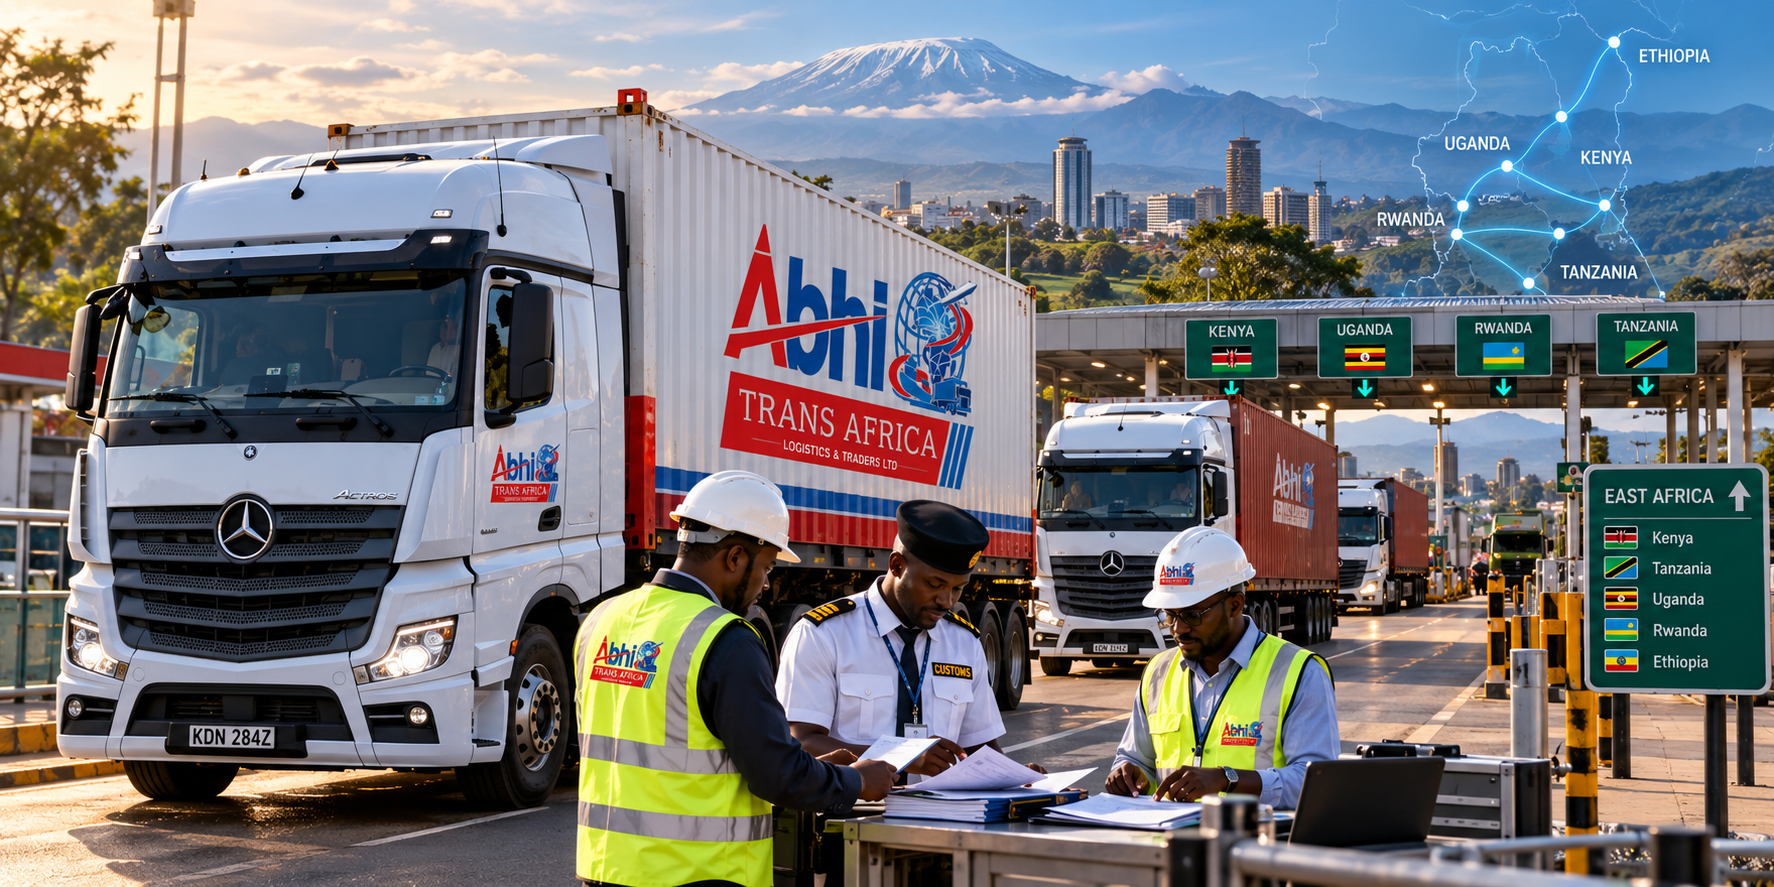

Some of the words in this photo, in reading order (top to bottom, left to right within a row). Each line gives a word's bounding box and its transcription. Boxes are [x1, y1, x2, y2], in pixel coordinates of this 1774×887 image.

[724, 223, 888, 392] Abhi
[1208, 325, 1255, 338] KENYA
[1337, 323, 1393, 336] UGANDA
[1475, 322, 1532, 334] RWANDA
[1614, 320, 1678, 333] TANZANIA
[739, 388, 835, 437] TRANS
[843, 412, 938, 459] AFRICA
[783, 438, 830, 458] LOGISTICS
[832, 449, 840, 460] &
[842, 450, 879, 468] TRADERS
[882, 457, 898, 471] LTD
[490, 444, 535, 482] Abhi
[1273, 452, 1301, 503] Abhi
[333, 489, 398, 501] ACTROS
[494, 486, 520, 496] TRANS
[1604, 488, 1648, 504] EAST
[1652, 488, 1715, 504] AFRICA
[1652, 531, 1694, 547] Kenya
[1652, 561, 1712, 575] Tanzania
[1653, 592, 1705, 608] Uganda
[1653, 623, 1708, 637] Rwanda
[593, 635, 638, 668] Abhi
[934, 663, 972, 678] CUSTOMS
[1653, 655, 1709, 671] Ethiopia
[193, 728, 226, 745] KDN
[231, 728, 271, 746] 284Z
